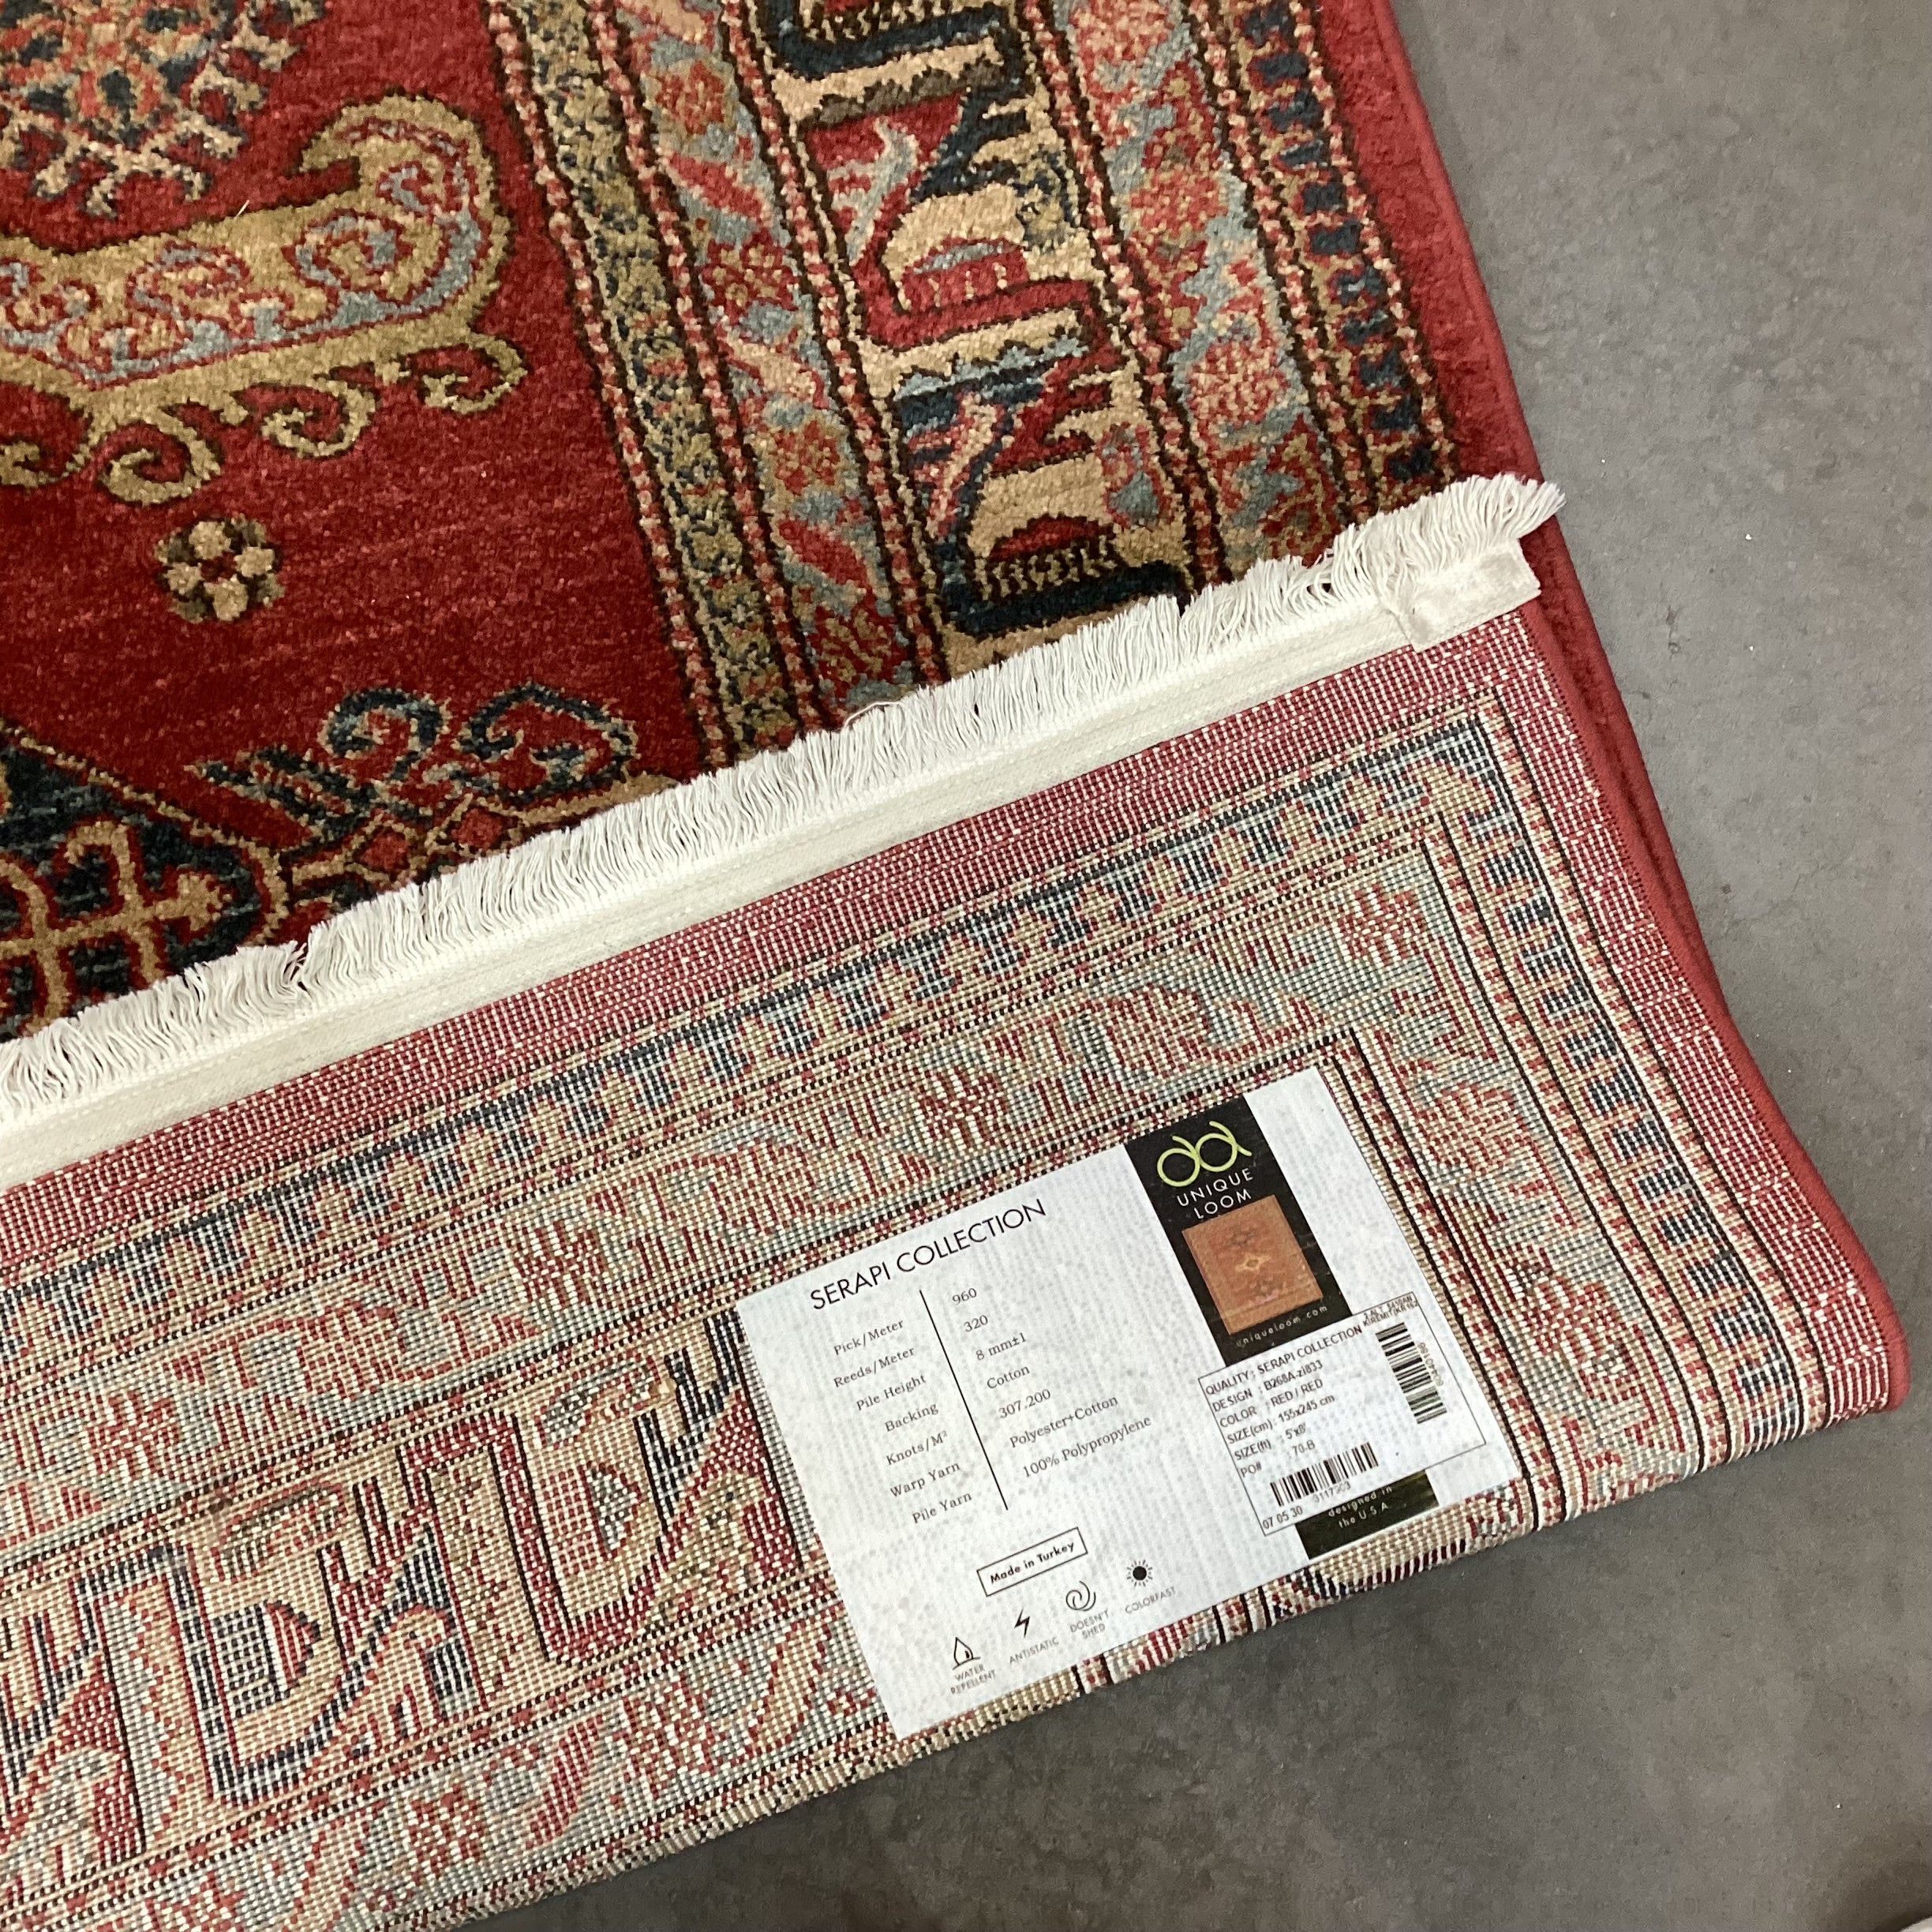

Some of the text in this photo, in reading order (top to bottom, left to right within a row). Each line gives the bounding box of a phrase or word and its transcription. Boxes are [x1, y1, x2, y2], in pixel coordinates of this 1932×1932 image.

[1177, 1168, 1253, 1207] UNIQUE
[1193, 1189, 1252, 1219] LOOM
[810, 1198, 1046, 1310] SERAPI COLLECTION
[952, 1288, 977, 1304] 960
[964, 1315, 989, 1332] 320
[833, 1320, 904, 1356] Pick/Meter
[975, 1332, 1027, 1361] 8 mm±1
[1257, 1352, 1296, 1375] SERAPI
[1297, 1324, 1363, 1358] COLLECTION
[833, 1348, 914, 1388] Reeds/Meter
[987, 1366, 1030, 1389] Cotton
[856, 1375, 926, 1411] Pile Height
[999, 1389, 1051, 1418] 307.200
[1212, 1388, 1253, 1413] DESIGN
[1219, 1406, 1257, 1428] COLOR
[1271, 1391, 1294, 1406] RED
[1301, 1379, 1324, 1395] RED
[885, 1404, 939, 1432] Backing
[1009, 1397, 1118, 1448] Polyester+Cotton
[1279, 1400, 1318, 1422] 155x245
[1320, 1395, 1335, 1406] cm
[1023, 1417, 1151, 1478] 100% Polypropylene
[1234, 1439, 1272, 1460] SIZE(ft)
[890, 1463, 960, 1497] Warp Yarn
[1382, 1486, 1393, 1495] in
[912, 1493, 972, 1524] Pile Yarn
[1262, 1505, 1303, 1530] 07 05 30
[1339, 1517, 1356, 1528] the
[990, 1542, 1074, 1584] Made in Turkey
[1125, 1586, 1176, 1614] COLORFAST
[1069, 1609, 1109, 1633] DOESN'T
[1082, 1623, 1106, 1639] SHED
[1009, 1637, 1059, 1664] ANTISTATIC
[950, 1669, 996, 1694] REPELLENT
[954, 1664, 985, 1682] WATER
